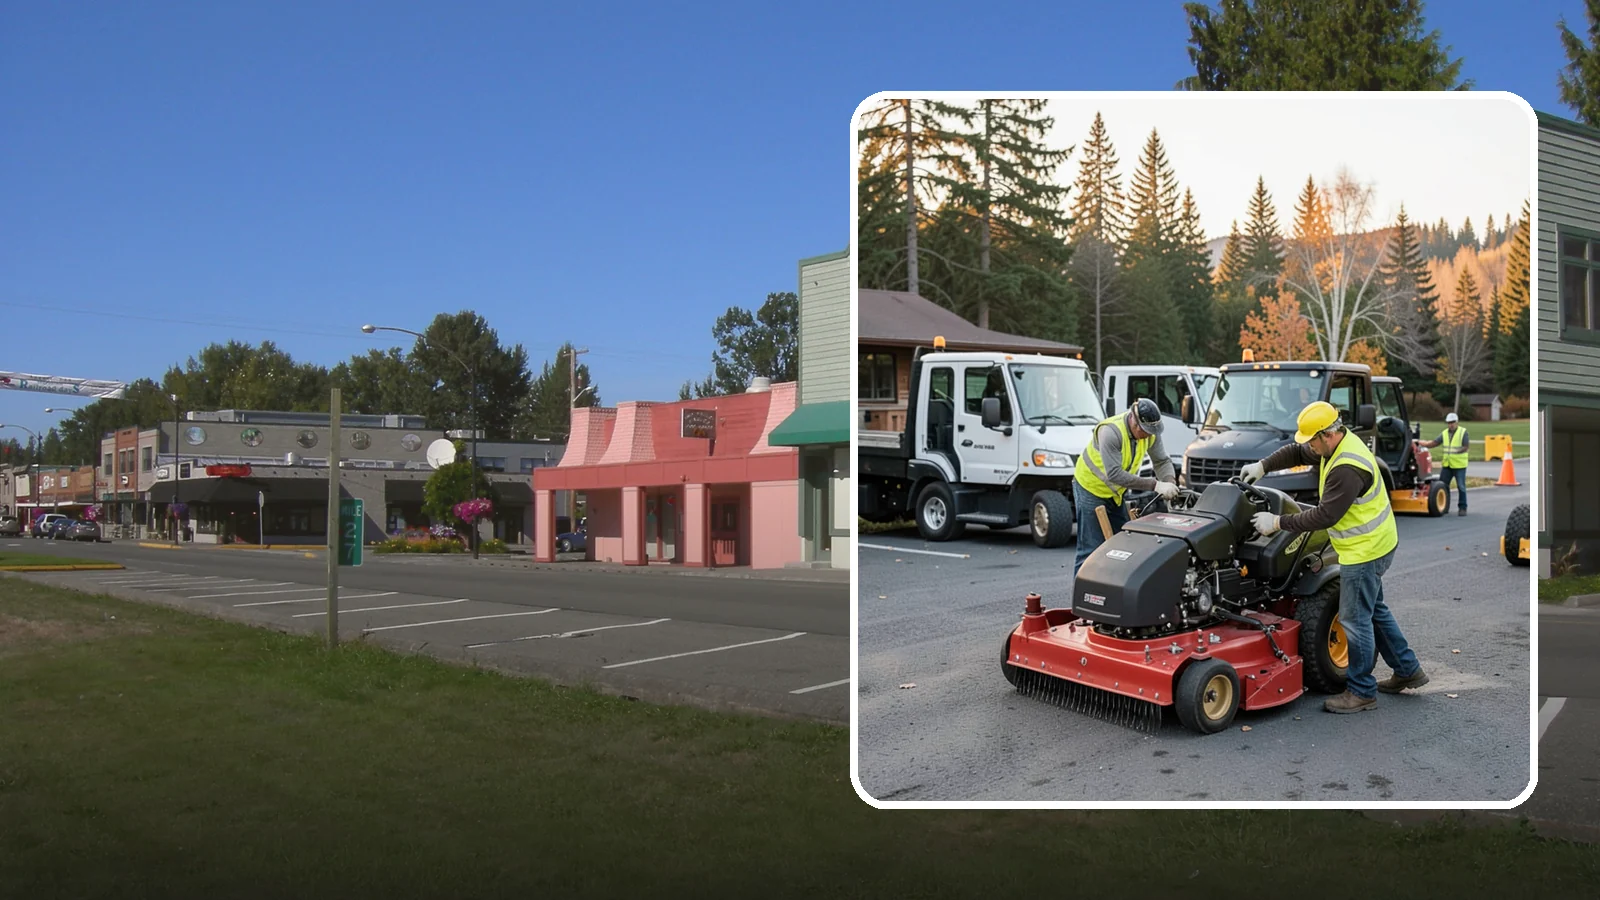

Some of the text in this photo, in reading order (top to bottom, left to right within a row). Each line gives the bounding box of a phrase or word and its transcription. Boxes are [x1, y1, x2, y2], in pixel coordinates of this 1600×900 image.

[20, 379, 57, 392] Railroad
[341, 505, 361, 517] MILE
[345, 522, 356, 538] 2
[344, 543, 356, 559] 7
